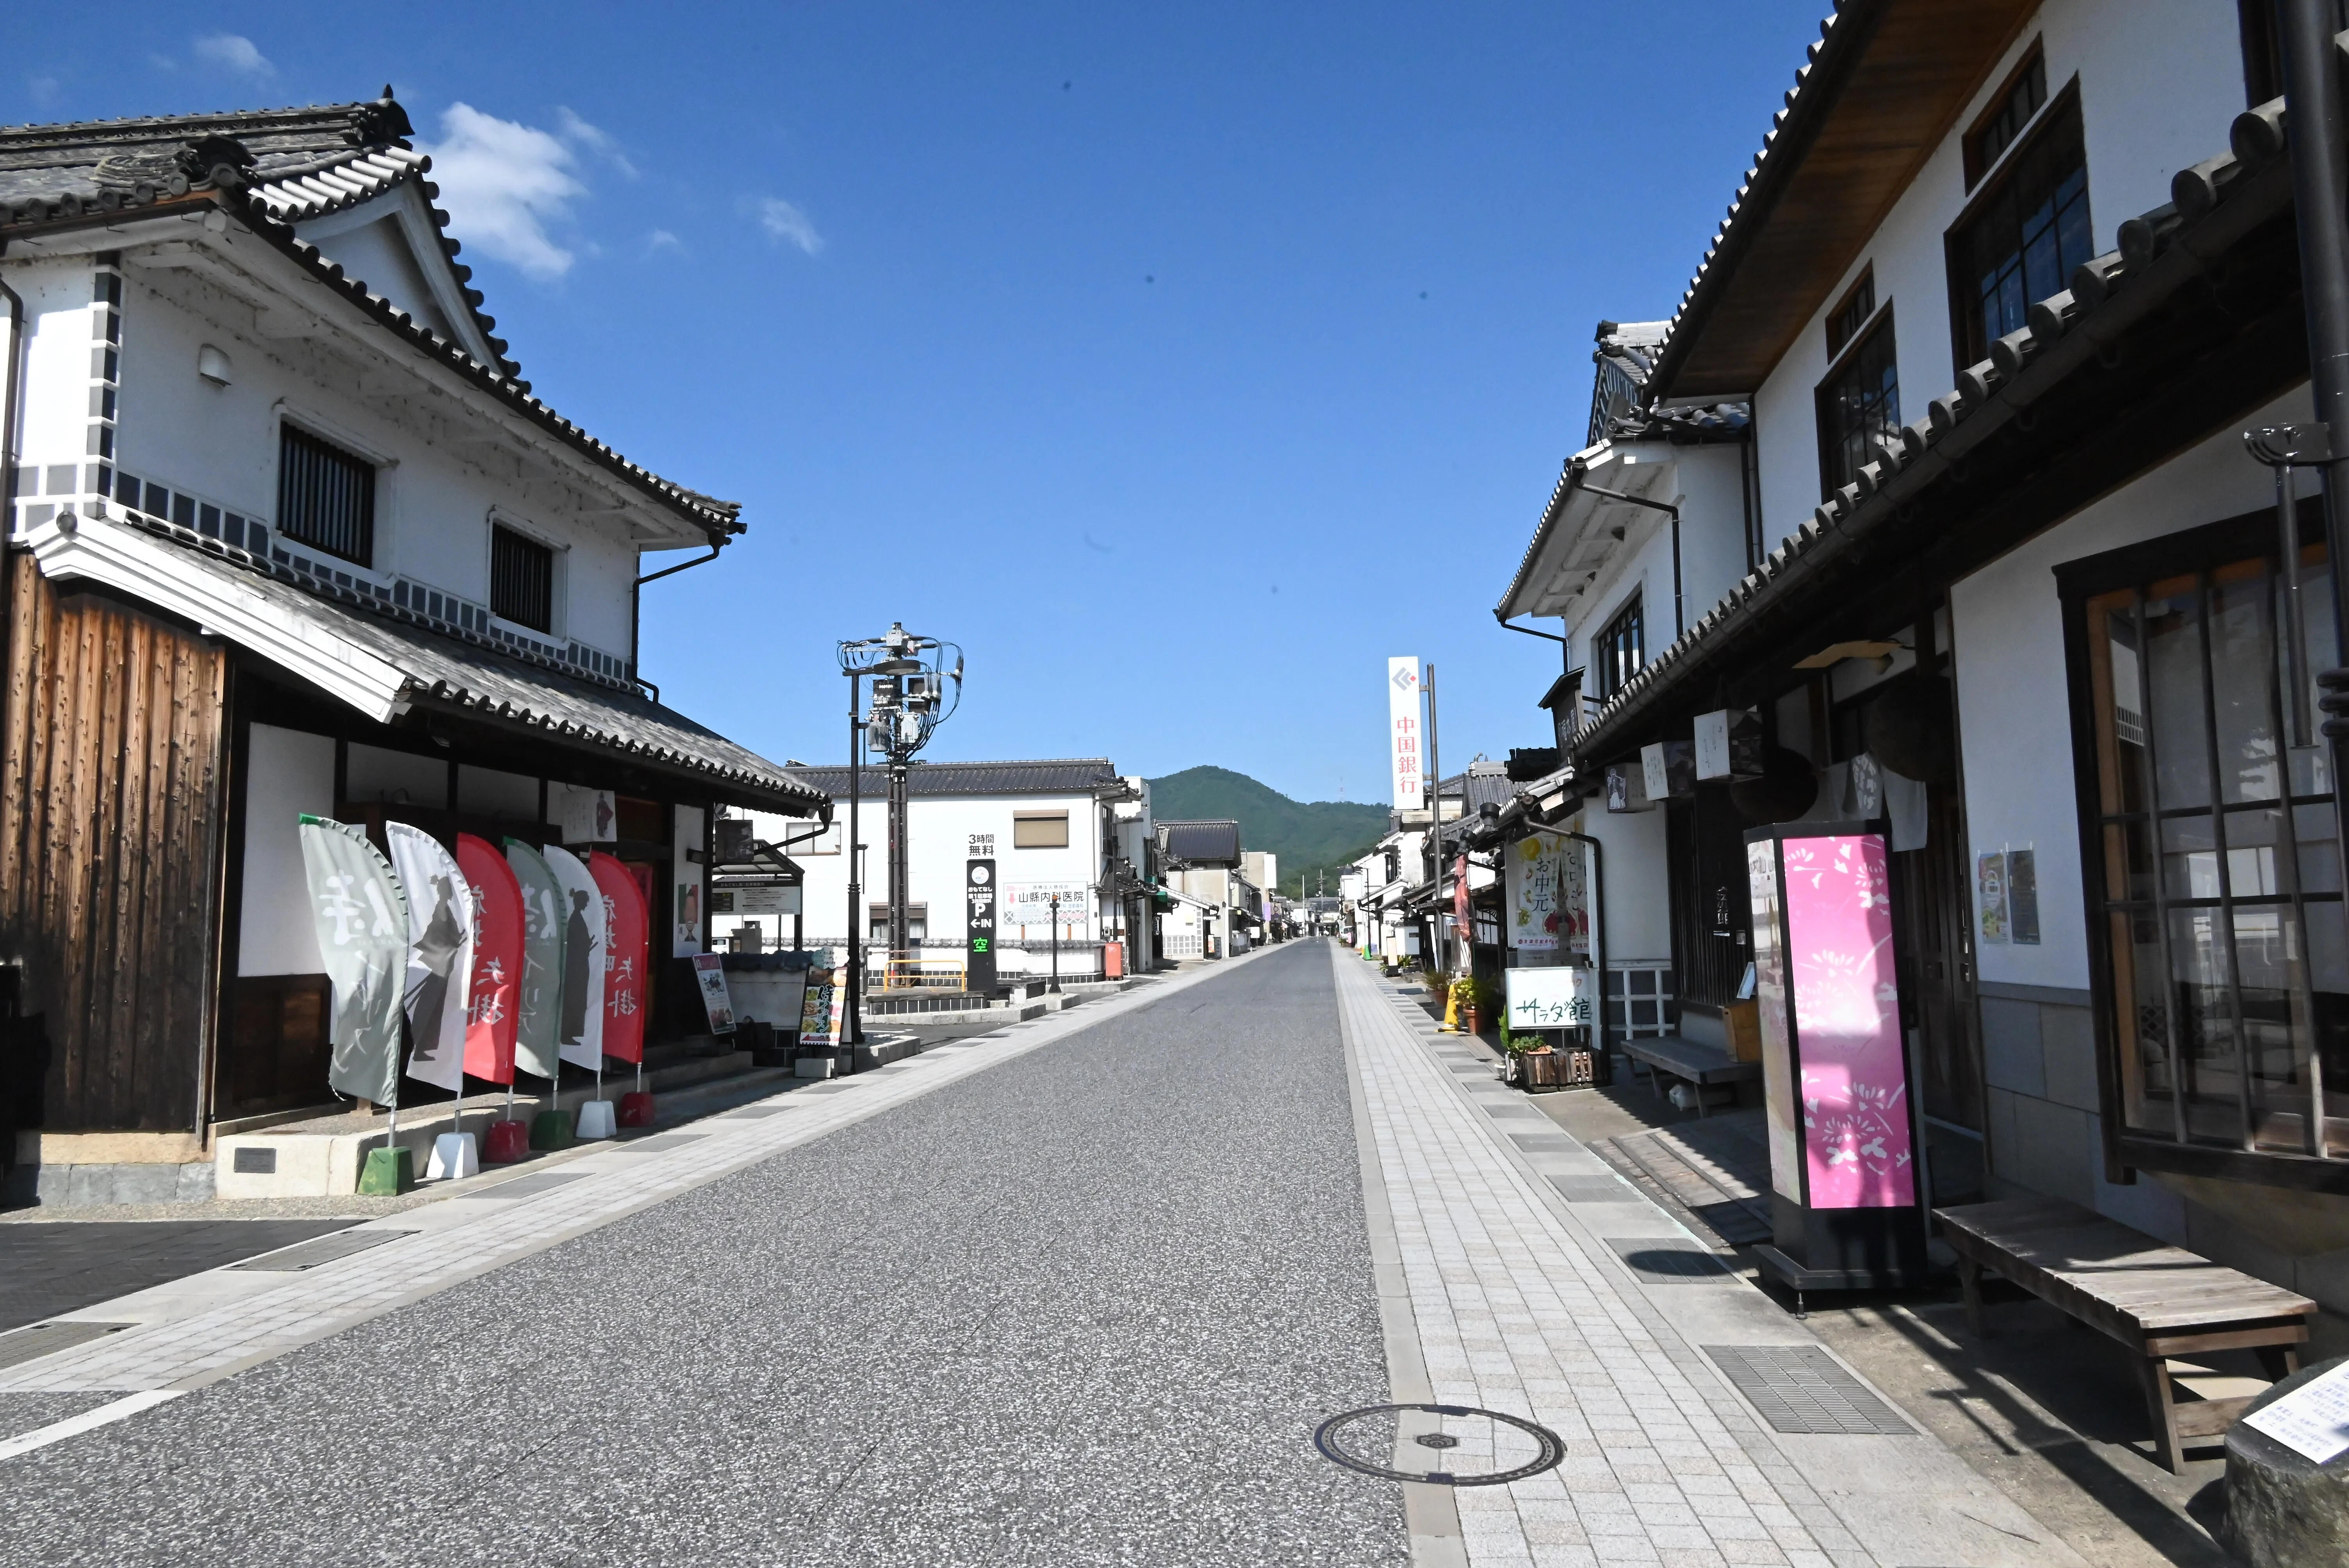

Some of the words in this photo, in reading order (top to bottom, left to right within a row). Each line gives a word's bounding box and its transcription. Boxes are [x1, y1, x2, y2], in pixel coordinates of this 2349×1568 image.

[1397, 716, 1417, 793] 中国銀行
[969, 834, 994, 844] 3時間
[969, 845, 994, 856] 無料
[1532, 857, 1550, 912] お中元
[975, 903, 986, 917] P
[981, 919, 992, 928] IN
[973, 937, 987, 952] 空
